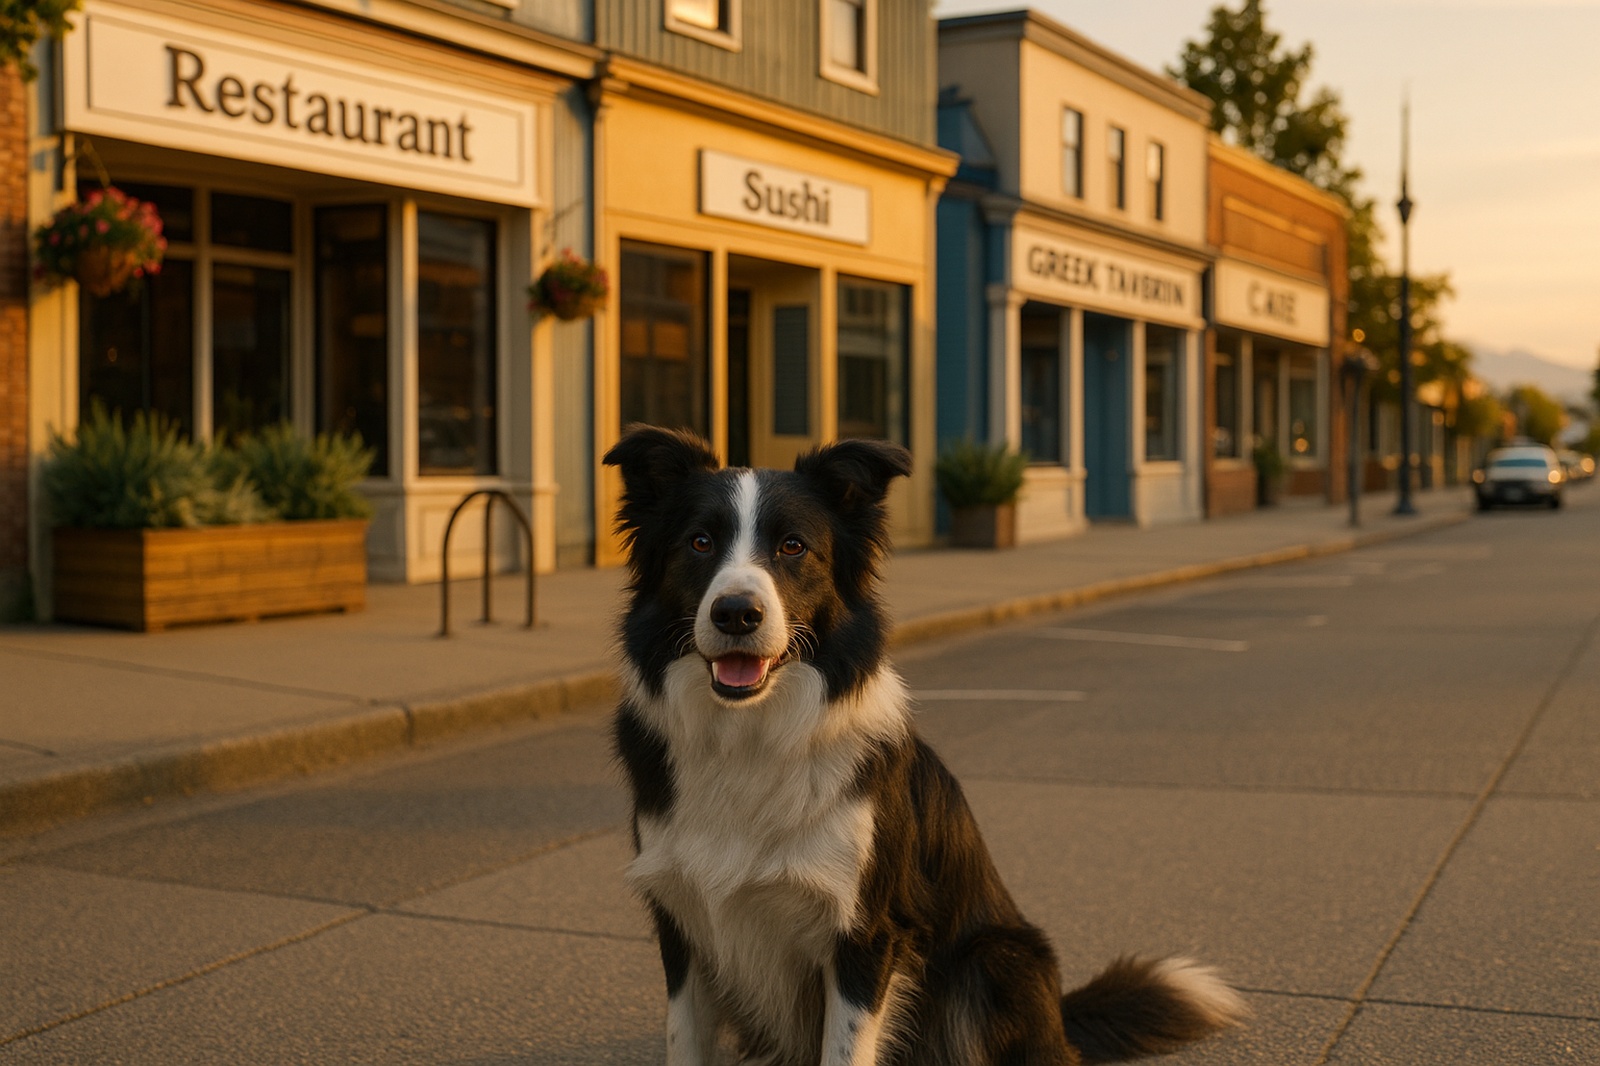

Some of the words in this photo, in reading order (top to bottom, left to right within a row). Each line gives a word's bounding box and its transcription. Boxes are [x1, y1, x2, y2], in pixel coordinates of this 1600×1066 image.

[164, 44, 474, 163] Restaurant
[742, 170, 831, 226] Sushi
[1027, 245, 1098, 291] GREEK
